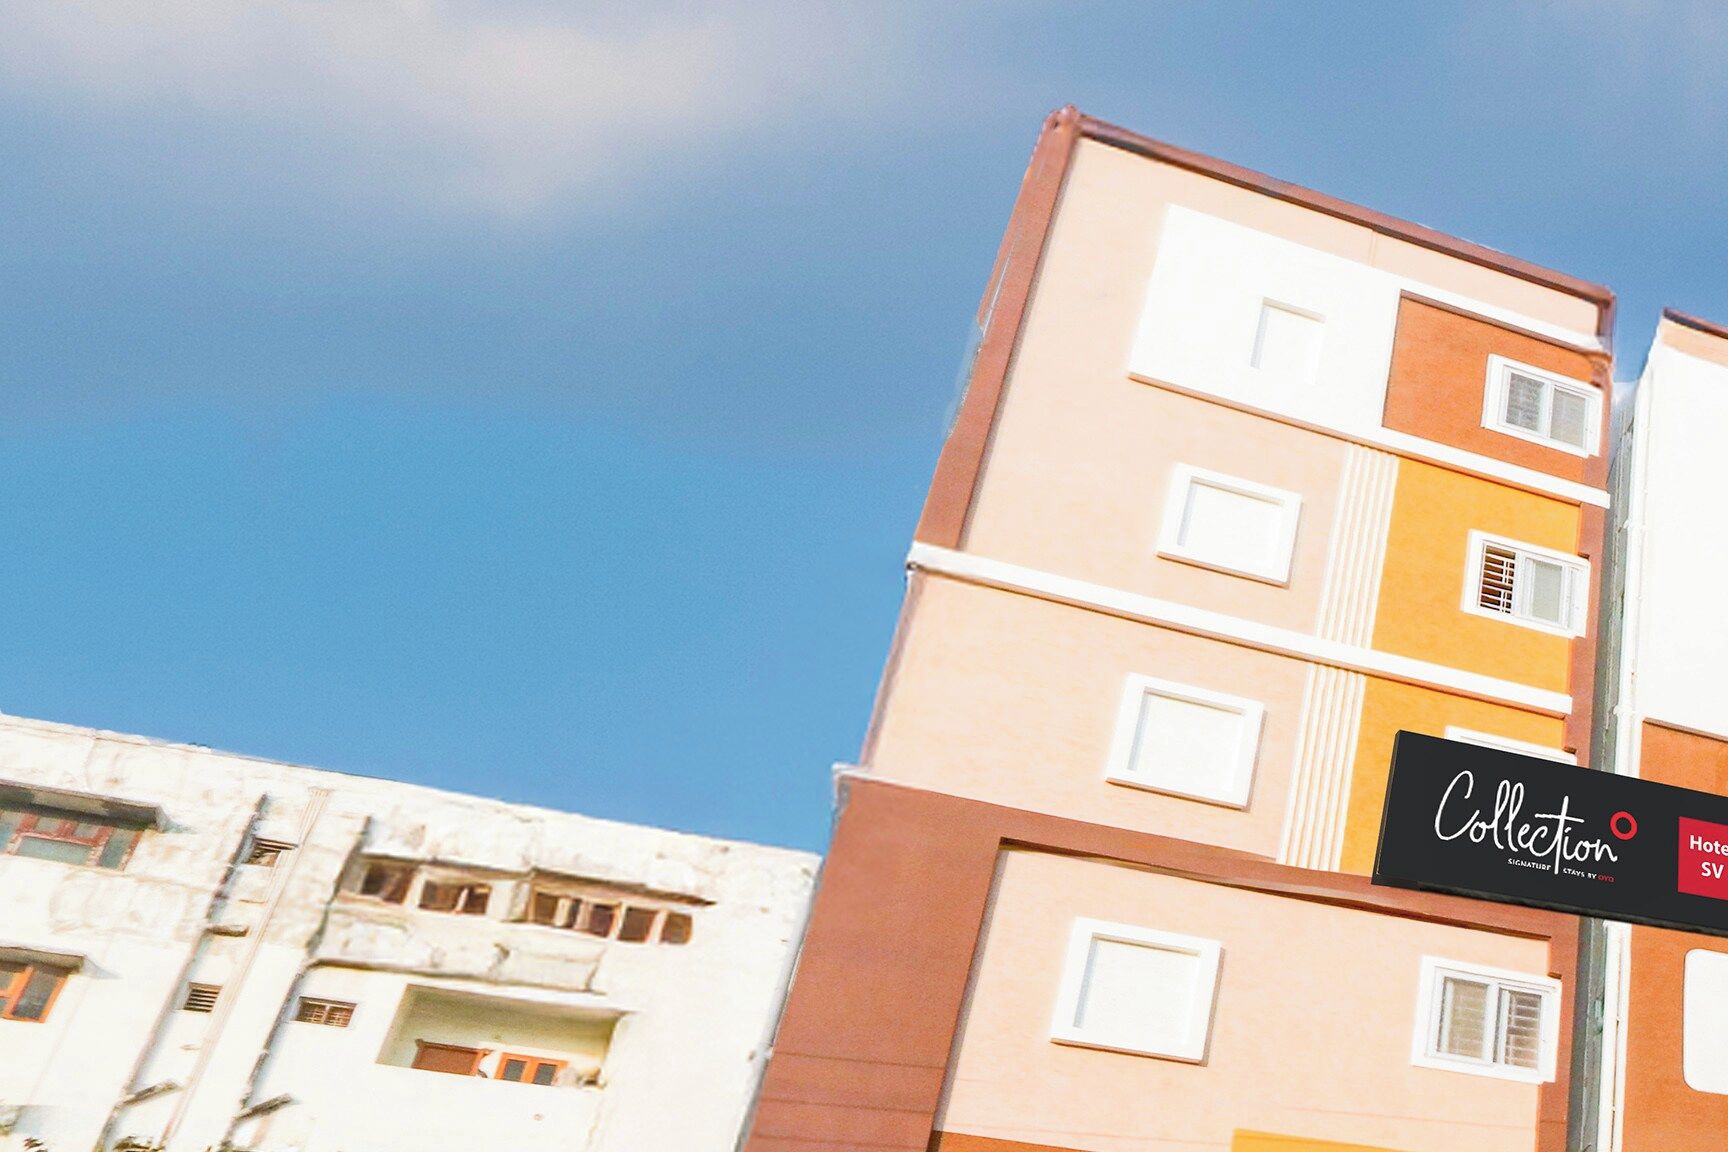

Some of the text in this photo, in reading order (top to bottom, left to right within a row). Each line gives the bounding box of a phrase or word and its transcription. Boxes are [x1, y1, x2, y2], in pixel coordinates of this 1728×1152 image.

[1434, 770, 1618, 875] Collection
[1508, 858, 1551, 870] SIGNATURE
[1562, 867, 1585, 877] STAYS
[1588, 872, 1598, 880] BY
[1701, 861, 1725, 879] SV
